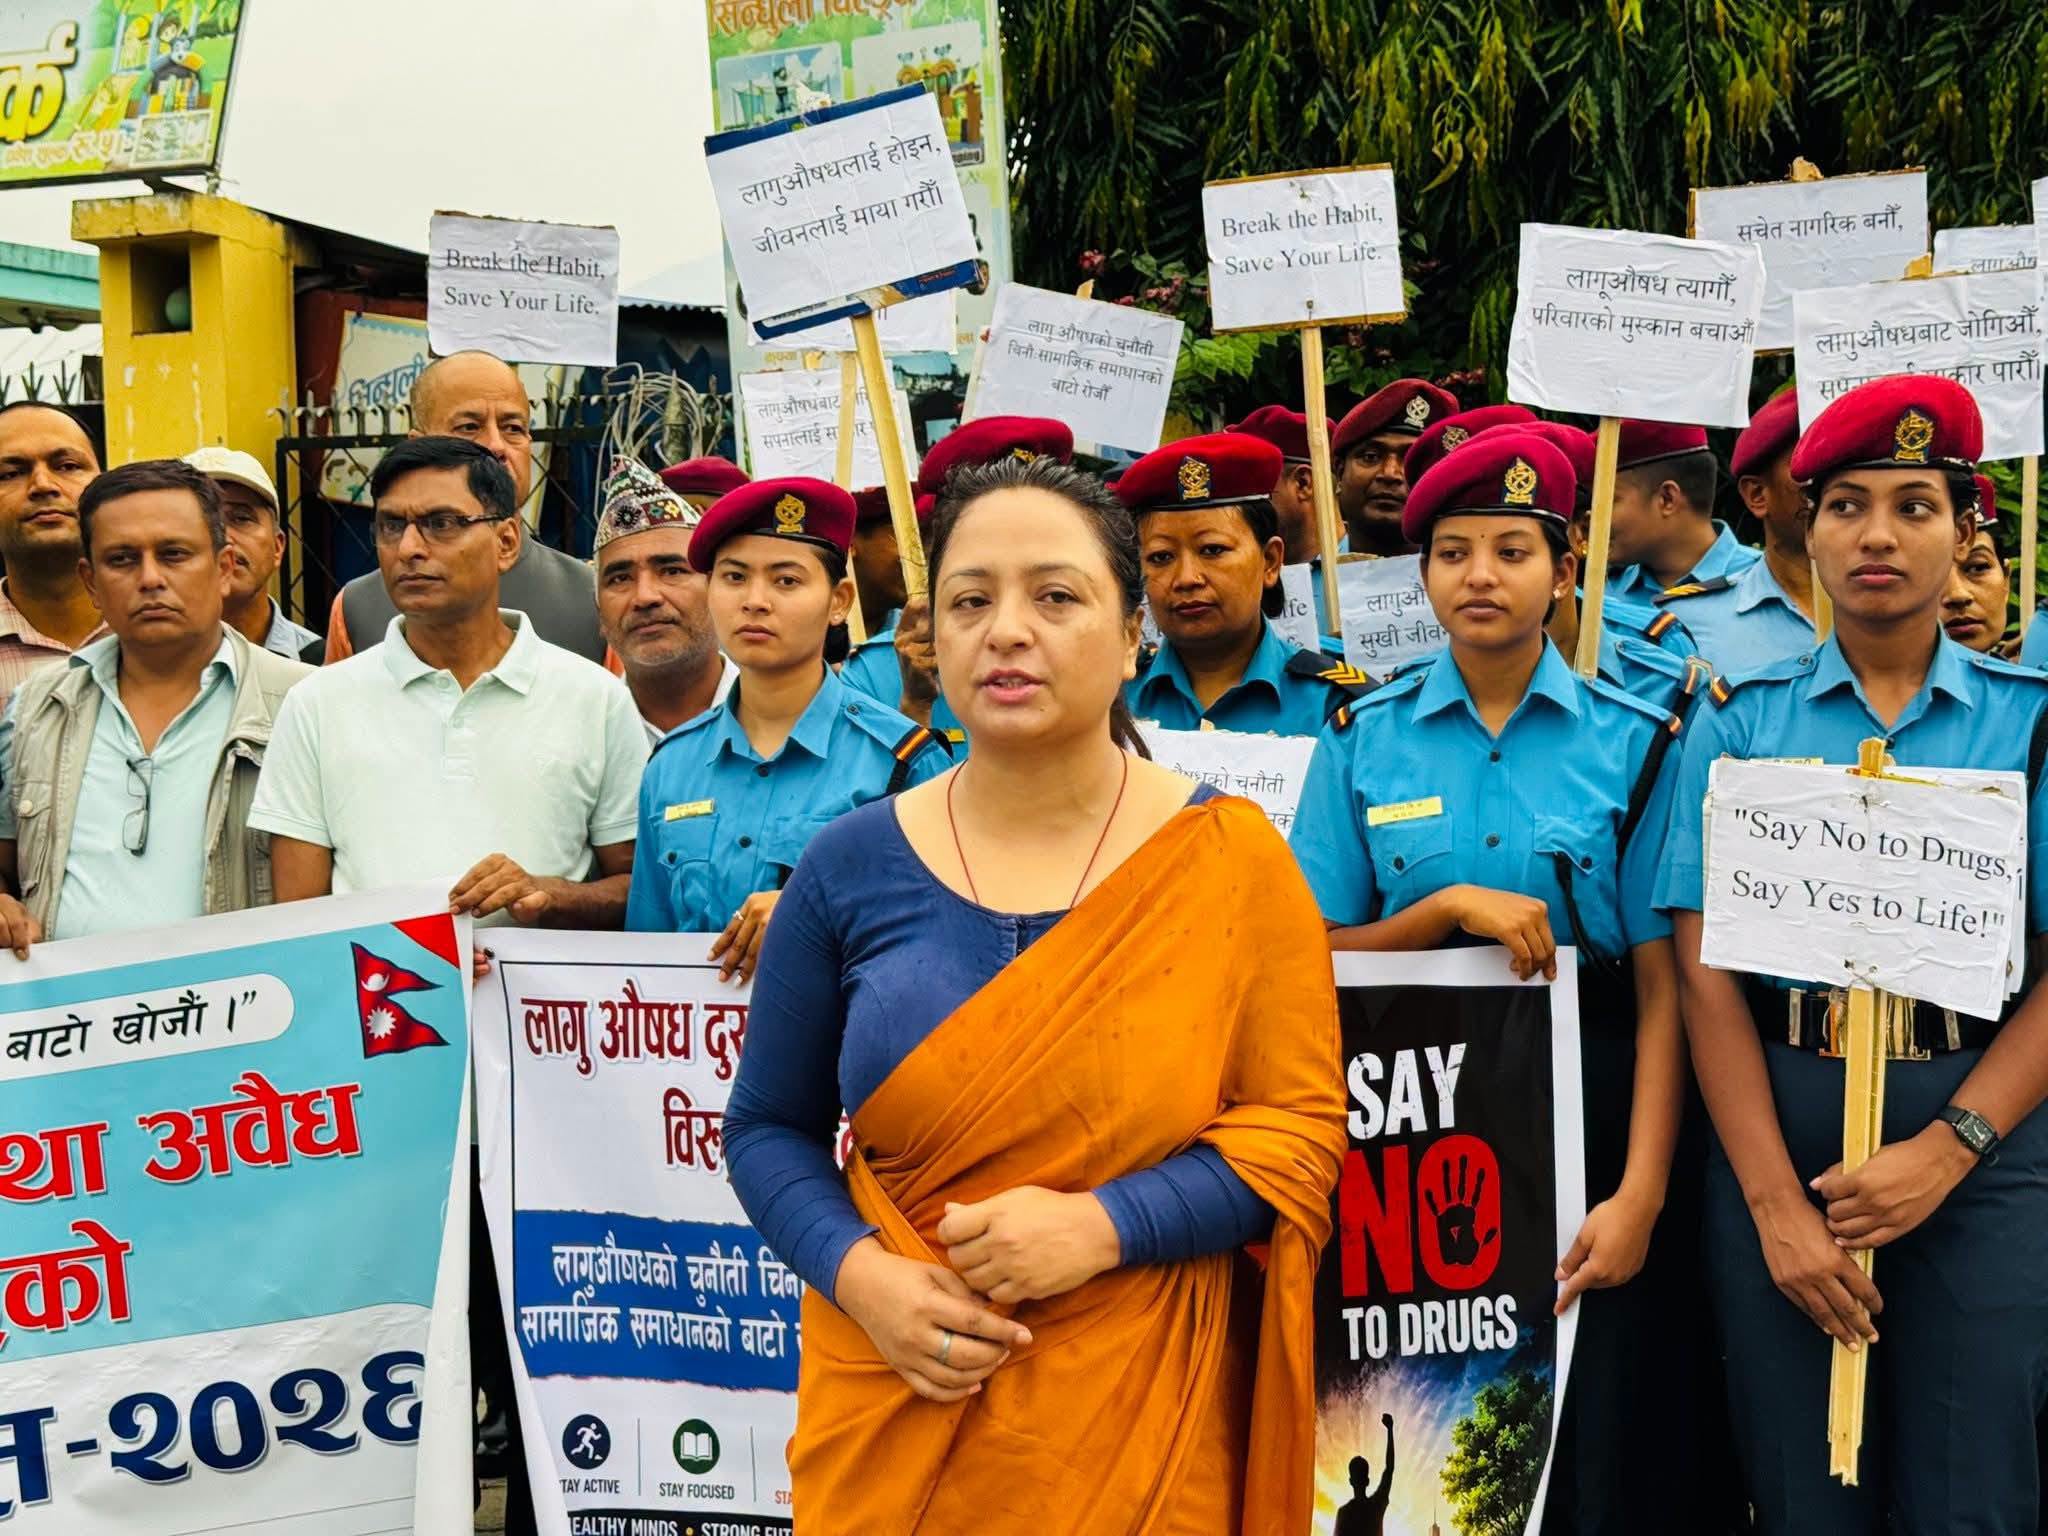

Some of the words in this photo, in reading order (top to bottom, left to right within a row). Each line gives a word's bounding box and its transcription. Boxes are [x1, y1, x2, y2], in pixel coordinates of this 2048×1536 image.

[738, 142, 882, 206] लागुऔषधलाई
[884, 134, 941, 164] होइन,
[752, 205, 849, 254] जीवनलाई
[851, 200, 898, 227] माया
[1221, 211, 1281, 237] Break
[1288, 210, 1318, 229] the
[1325, 203, 1383, 226] Habit,
[1737, 216, 1782, 242] सचेत
[1789, 211, 1857, 237] नागरिक
[446, 248, 503, 271] Break
[511, 253, 540, 272] the
[546, 256, 605, 279] Habit,
[1225, 256, 1274, 276] Save
[1280, 248, 1333, 268] Your
[1338, 243, 1381, 263] Life.
[444, 286, 492, 306] Save
[499, 290, 548, 311] Your
[555, 294, 600, 315] Life.
[1565, 265, 1669, 301] लागूऔषध
[1028, 320, 1055, 343] लागु
[1058, 323, 1111, 348] औषधको
[1115, 336, 1155, 358] चुनौती
[1532, 302, 1613, 332] परिवारको
[1621, 315, 1684, 343] मुस्कान
[1815, 320, 1953, 361] लागुऔषधबाट
[1038, 350, 1096, 371] सामाजिक
[1098, 362, 1164, 386] समाधानको
[1050, 377, 1079, 395] बाटो
[760, 422, 822, 448] सपनालाई
[1359, 623, 1400, 658] सुखी
[1735, 809, 1808, 850] "Say
[1819, 819, 1866, 852] No
[1878, 832, 1908, 858] to
[1920, 836, 2013, 882] Drugs,
[1732, 870, 1789, 909] Say
[1802, 879, 1860, 914] Yes
[1872, 895, 1903, 920] to
[1914, 896, 2006, 938] Life!"
[6, 1014, 92, 1061] बाटो
[521, 997, 592, 1075] लागु
[598, 978, 694, 1059] औषध
[1346, 1042, 1467, 1140] SAY
[137, 1072, 362, 1183] अवैध
[1338, 1133, 1502, 1297] NO
[0, 1219, 132, 1350] को
[551, 1230, 678, 1299] लागुऔषधको
[685, 1240, 749, 1308] चुनौती
[520, 1290, 621, 1348] सामाजिक
[628, 1306, 732, 1354] समाधानको
[739, 1309, 788, 1358] बाटो
[1341, 1304, 1388, 1361] TO
[1398, 1294, 1519, 1357] DRUGS
[559, 1479, 581, 1494] TAY
[583, 1479, 620, 1494] ACTIVE
[659, 1482, 685, 1498] STAY
[687, 1483, 735, 1500] FOCUSED
[567, 1515, 627, 1536] EALTHY
[630, 1519, 678, 1536] MINDS
[701, 1523, 760, 1536] STRONG
